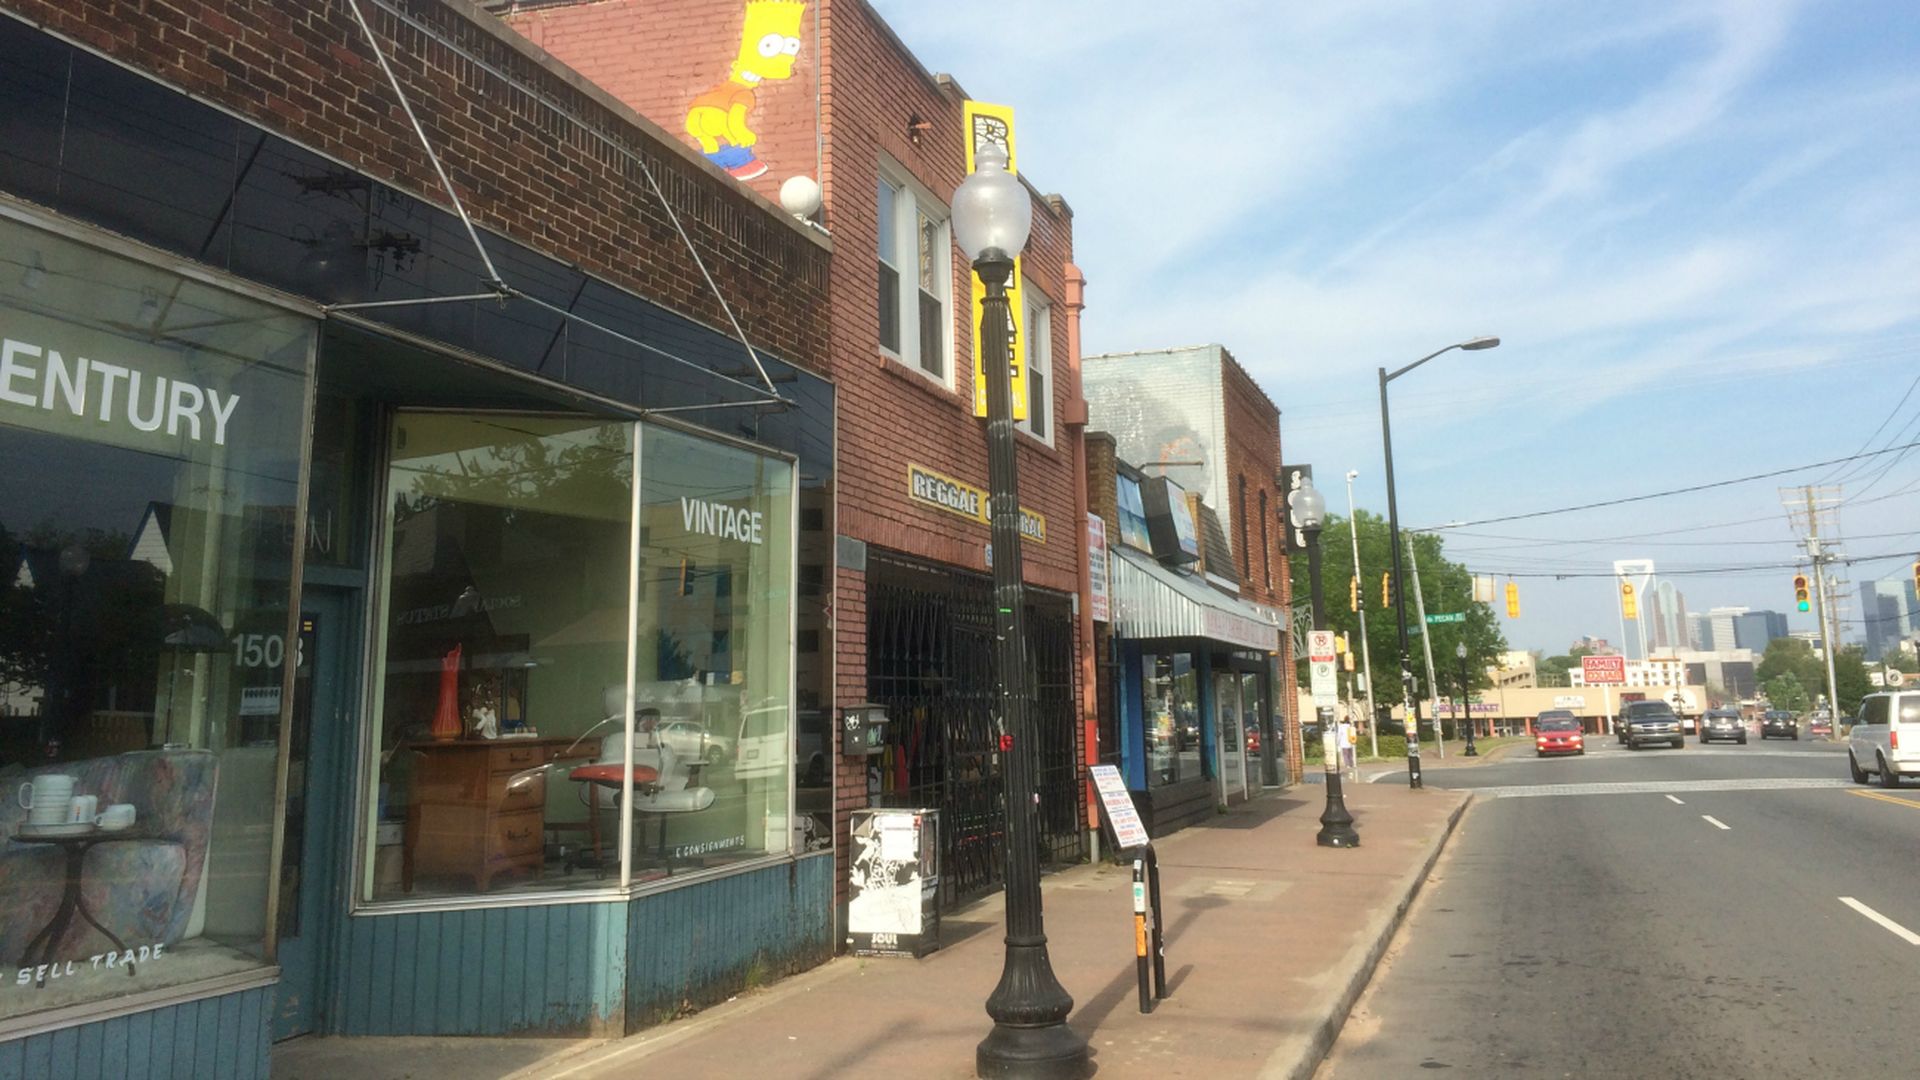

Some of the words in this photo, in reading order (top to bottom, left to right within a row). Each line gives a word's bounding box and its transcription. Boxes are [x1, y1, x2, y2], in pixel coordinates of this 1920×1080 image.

[0, 338, 240, 445] ENTURY
[912, 469, 979, 516] REGGAE
[681, 496, 763, 544] VINTAGE
[1585, 659, 1620, 670] FAMILY
[1586, 670, 1622, 681] DOLLAR
[16, 960, 75, 985] SELL
[90, 943, 165, 971] TRADE
